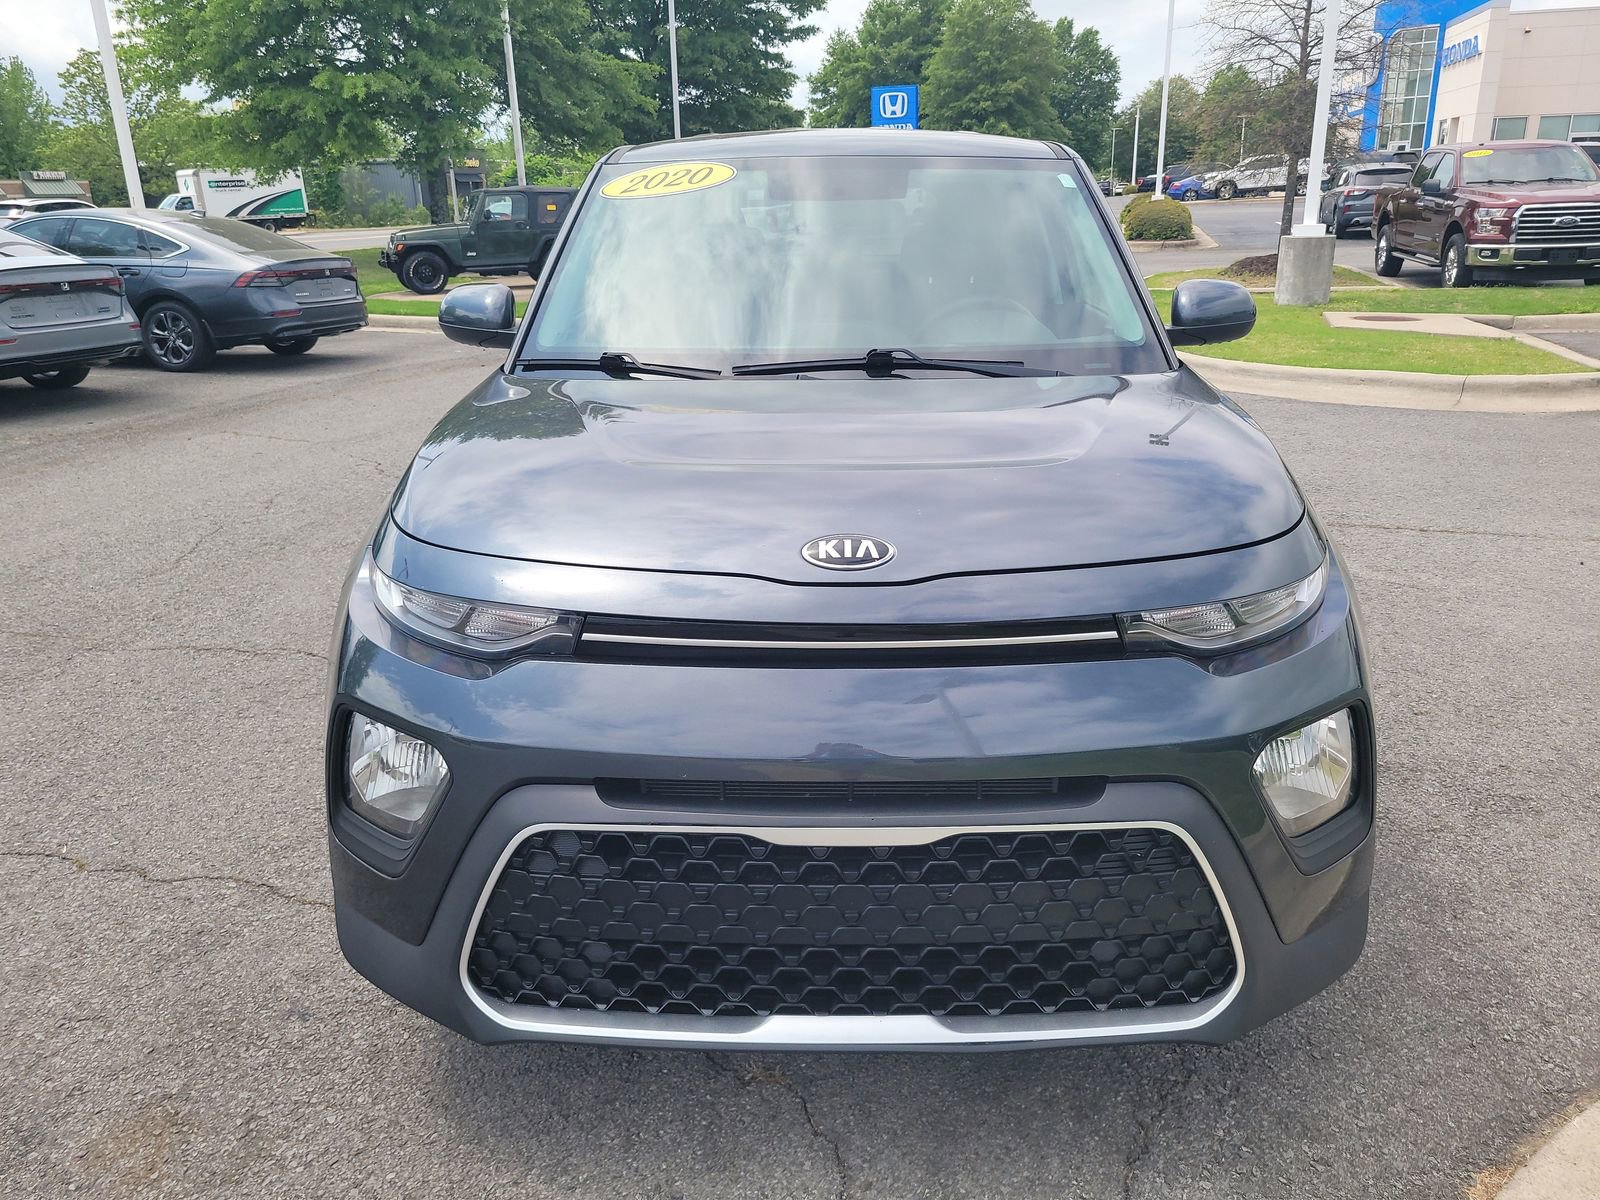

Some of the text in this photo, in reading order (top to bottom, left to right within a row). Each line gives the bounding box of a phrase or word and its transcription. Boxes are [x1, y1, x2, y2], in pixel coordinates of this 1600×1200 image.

[1441, 35, 1481, 67] HONDA
[620, 166, 714, 195] 2020
[818, 539, 880, 559] KIA
